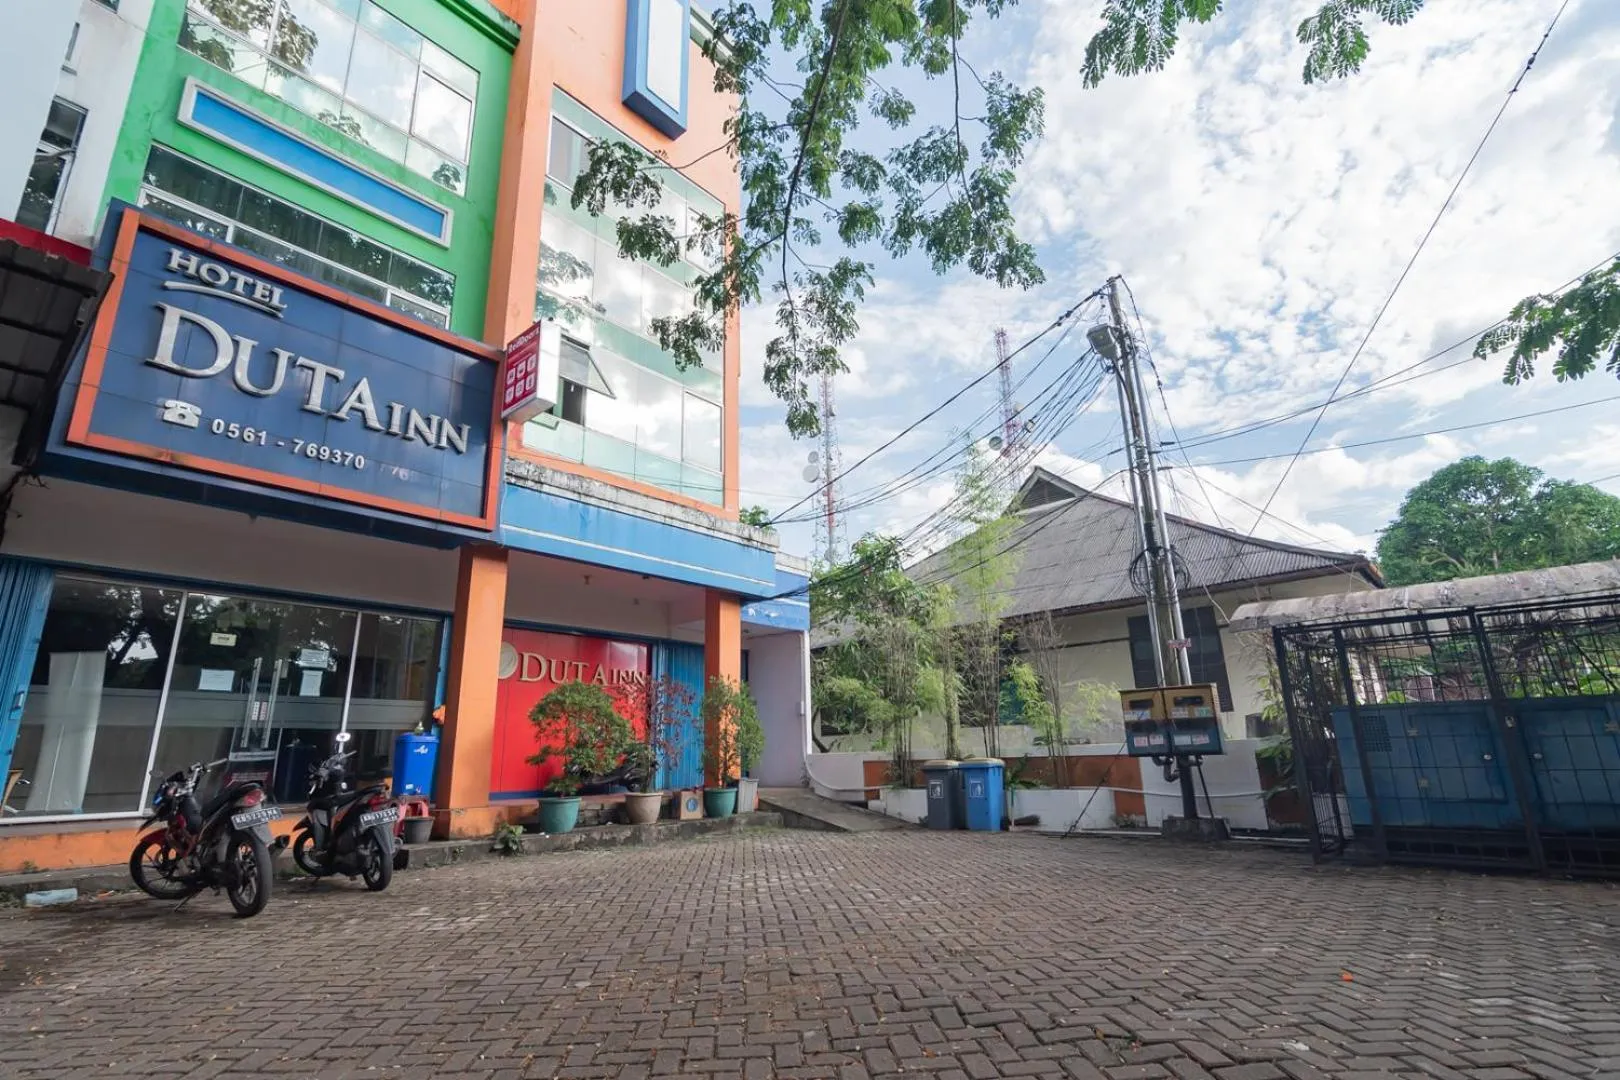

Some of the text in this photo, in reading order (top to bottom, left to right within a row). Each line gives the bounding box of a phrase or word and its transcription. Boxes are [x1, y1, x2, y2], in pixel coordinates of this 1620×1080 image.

[166, 248, 287, 309] HOTEL
[211, 418, 267, 446] 0561
[292, 438, 365, 470] 769370
[519, 652, 608, 686] DUTA
